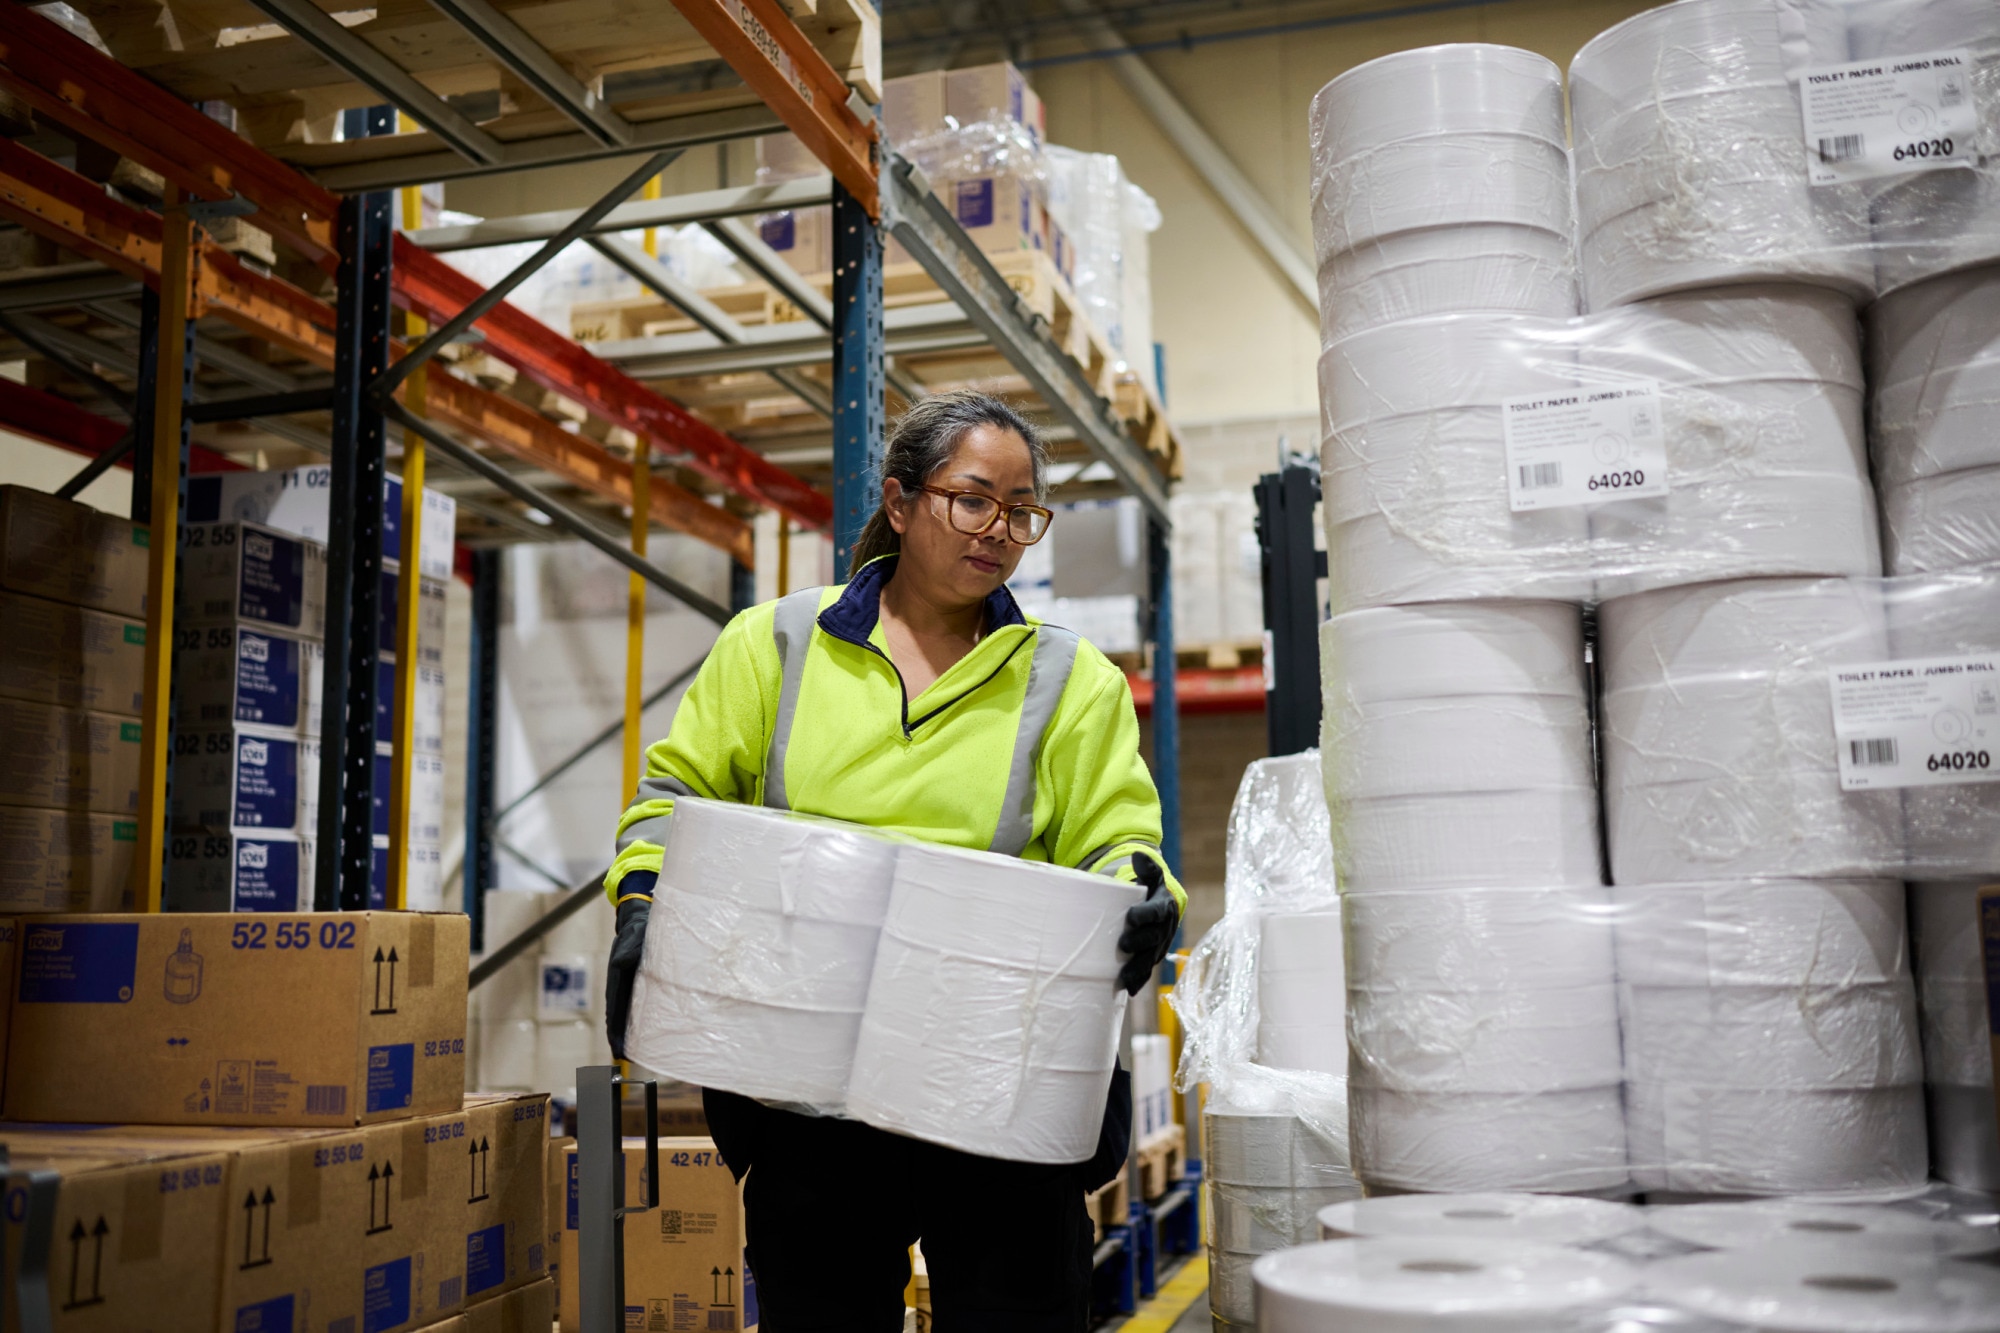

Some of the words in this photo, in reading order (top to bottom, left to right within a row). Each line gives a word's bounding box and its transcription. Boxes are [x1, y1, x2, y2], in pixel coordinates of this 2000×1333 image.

[1808, 72, 1845, 84] TOILET
[1849, 67, 1882, 79] PAPER
[1891, 61, 1930, 74] JUMBO
[1933, 56, 1963, 68] ROLL
[1893, 138, 1954, 161] 64020
[1510, 401, 1544, 412] TOILET
[1547, 396, 1579, 407] PAPER
[1587, 390, 1623, 403] JUMBO
[281, 472, 299, 488] 11
[306, 469, 331, 488] 02
[1588, 470, 1645, 491] 64020
[211, 524, 236, 546] 55
[207, 628, 232, 648] 55
[1838, 671, 1875, 682] TOILET
[1879, 668, 1914, 679] PAPER
[1923, 665, 1963, 676] JUMBO
[1966, 662, 1995, 672] ROLL
[176, 734, 200, 754] 02
[206, 732, 232, 754] 55
[1927, 750, 1990, 772] 64020
[172, 838, 197, 859] 02
[203, 837, 229, 859] 55
[30, 936, 61, 949] TORK
[231, 922, 267, 949] 52
[275, 922, 311, 949] 55
[319, 921, 356, 949] 02
[424, 1041, 437, 1057] 52
[439, 1039, 450, 1055] 55
[452, 1038, 464, 1054] 02
[514, 1107, 525, 1121] 52
[526, 1105, 537, 1119] 55
[424, 1127, 437, 1143] 52
[439, 1125, 450, 1141] 55
[452, 1122, 465, 1138] 02
[314, 1148, 330, 1168] 52
[331, 1145, 347, 1164] 55
[348, 1143, 364, 1161] 02
[670, 1152, 689, 1167] 42
[693, 1152, 711, 1167] 47
[160, 1171, 178, 1193] 52
[182, 1168, 200, 1190] 55
[203, 1165, 223, 1186] 02
